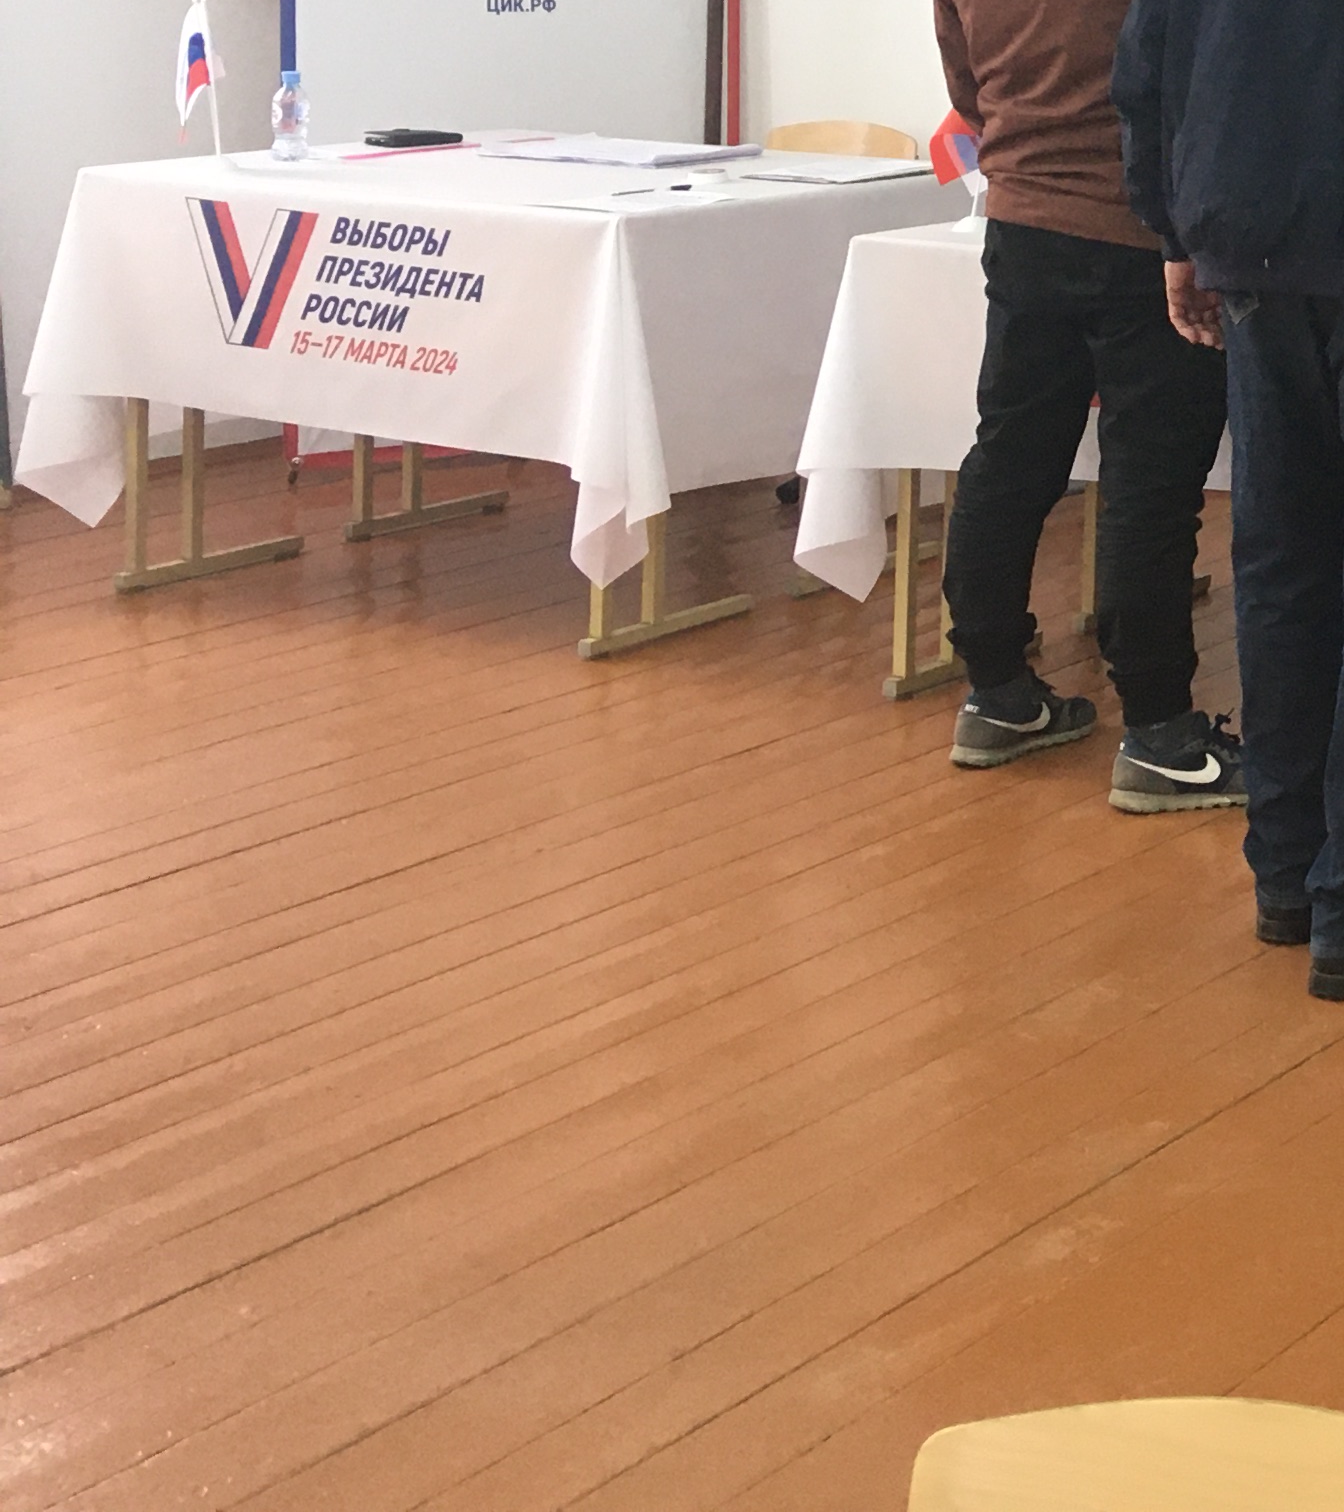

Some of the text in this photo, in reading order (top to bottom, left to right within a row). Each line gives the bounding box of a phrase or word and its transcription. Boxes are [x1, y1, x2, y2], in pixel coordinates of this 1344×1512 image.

[330, 216, 451, 258] ВЫБОРЫ
[314, 255, 486, 304] ПРЕЗИДЕНТА
[300, 293, 410, 334] РОССИИ
[345, 336, 407, 370] МАРТА
[409, 346, 459, 376] 2024
